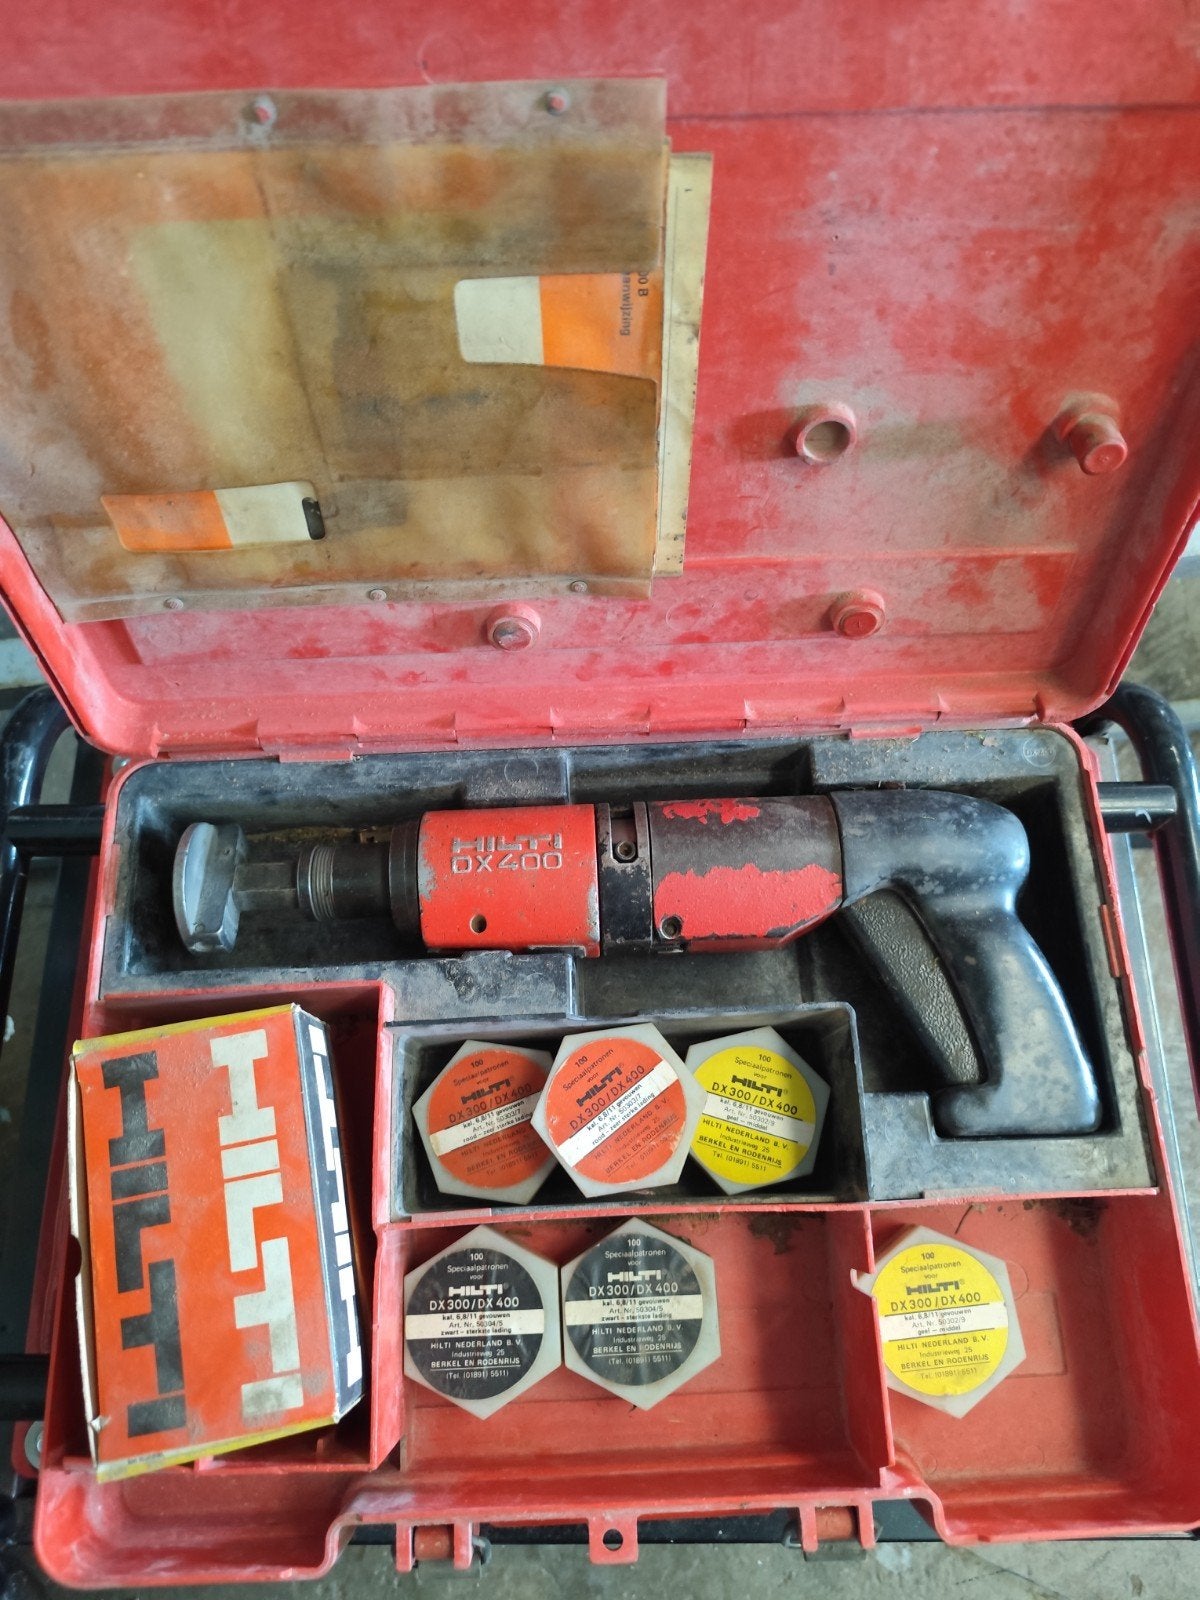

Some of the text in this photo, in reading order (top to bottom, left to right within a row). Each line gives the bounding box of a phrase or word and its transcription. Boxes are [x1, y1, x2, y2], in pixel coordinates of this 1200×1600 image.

[452, 833, 563, 853] HILTI
[452, 852, 563, 874] DX 400
[562, 1047, 614, 1091] Speciaalpatronen
[734, 1056, 792, 1079] Speciaalpatronen
[586, 1071, 599, 1083] voor
[460, 1078, 510, 1104] HILTI
[575, 1066, 622, 1107] HILTI
[730, 1074, 782, 1096] HILTI
[613, 1109, 653, 1143] NEDERLAND
[702, 1119, 722, 1129] HILTI
[725, 1126, 770, 1143] NEDERLAND
[719, 1133, 758, 1150] Industrieweg
[698, 1135, 727, 1148] BERKEL
[741, 1148, 782, 1165] RODENRIJS
[209, 1029, 304, 1418] HILTI
[101, 1050, 186, 1438] HILTI
[604, 1247, 666, 1259] Speciaalpatronen
[447, 1262, 508, 1272] Speciaalpatronen
[900, 1260, 961, 1274] Speciaalpatronen
[607, 1269, 661, 1282] HILTI
[448, 1283, 502, 1297] HILTI
[906, 1280, 959, 1295] HILTI
[616, 1325, 663, 1333] NEDERLAND
[455, 1339, 502, 1347] NEDERLAND
[592, 1345, 623, 1353] BERKEL
[922, 1337, 968, 1347] NEDERLAND
[451, 1349, 492, 1358] Industrieweg
[919, 1348, 960, 1358] Industrieweg
[477, 1357, 519, 1365] RODENRIJS
[901, 1360, 931, 1369] BERKEL
[946, 1353, 989, 1364] RODENRIJS
